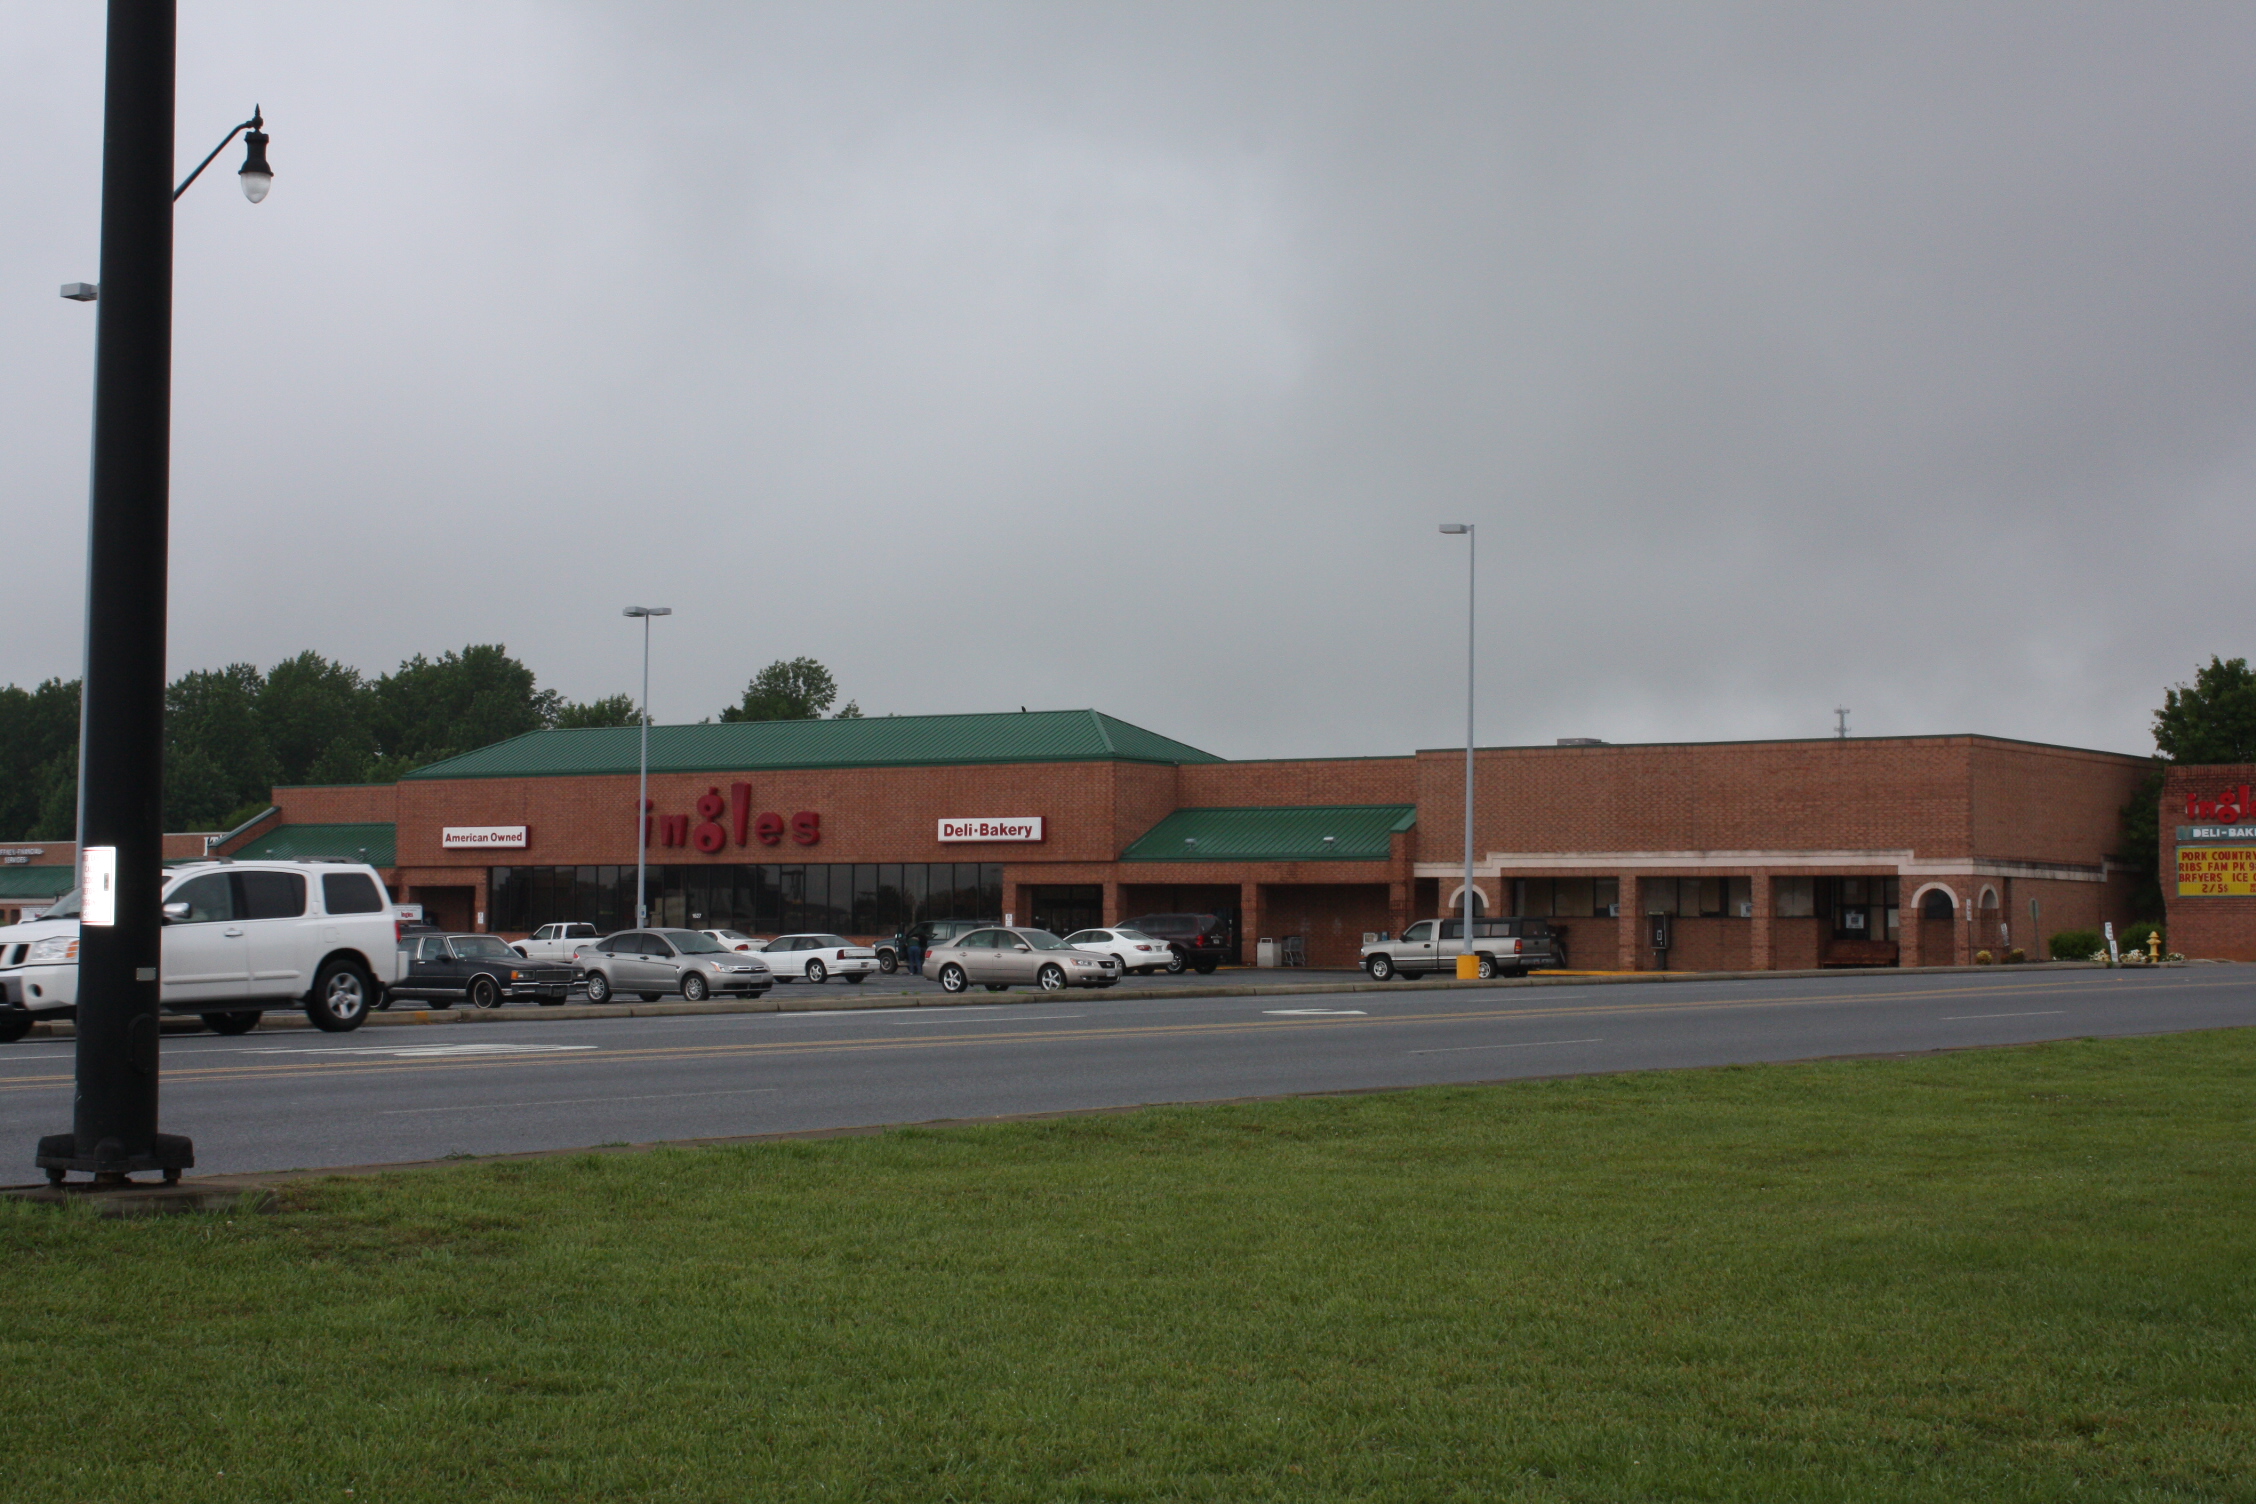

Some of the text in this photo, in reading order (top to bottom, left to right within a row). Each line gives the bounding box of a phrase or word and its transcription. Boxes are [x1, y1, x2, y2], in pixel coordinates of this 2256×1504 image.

[635, 782, 821, 853] ingles
[445, 832, 523, 842] American Owned
[2192, 828, 2256, 838] DELI-BAK
[2181, 851, 2207, 861] PORK
[2178, 862, 2202, 872] RIBS
[2207, 862, 2228, 872] FAM
[2232, 862, 2246, 871] PK
[2232, 873, 2249, 882] ICE
